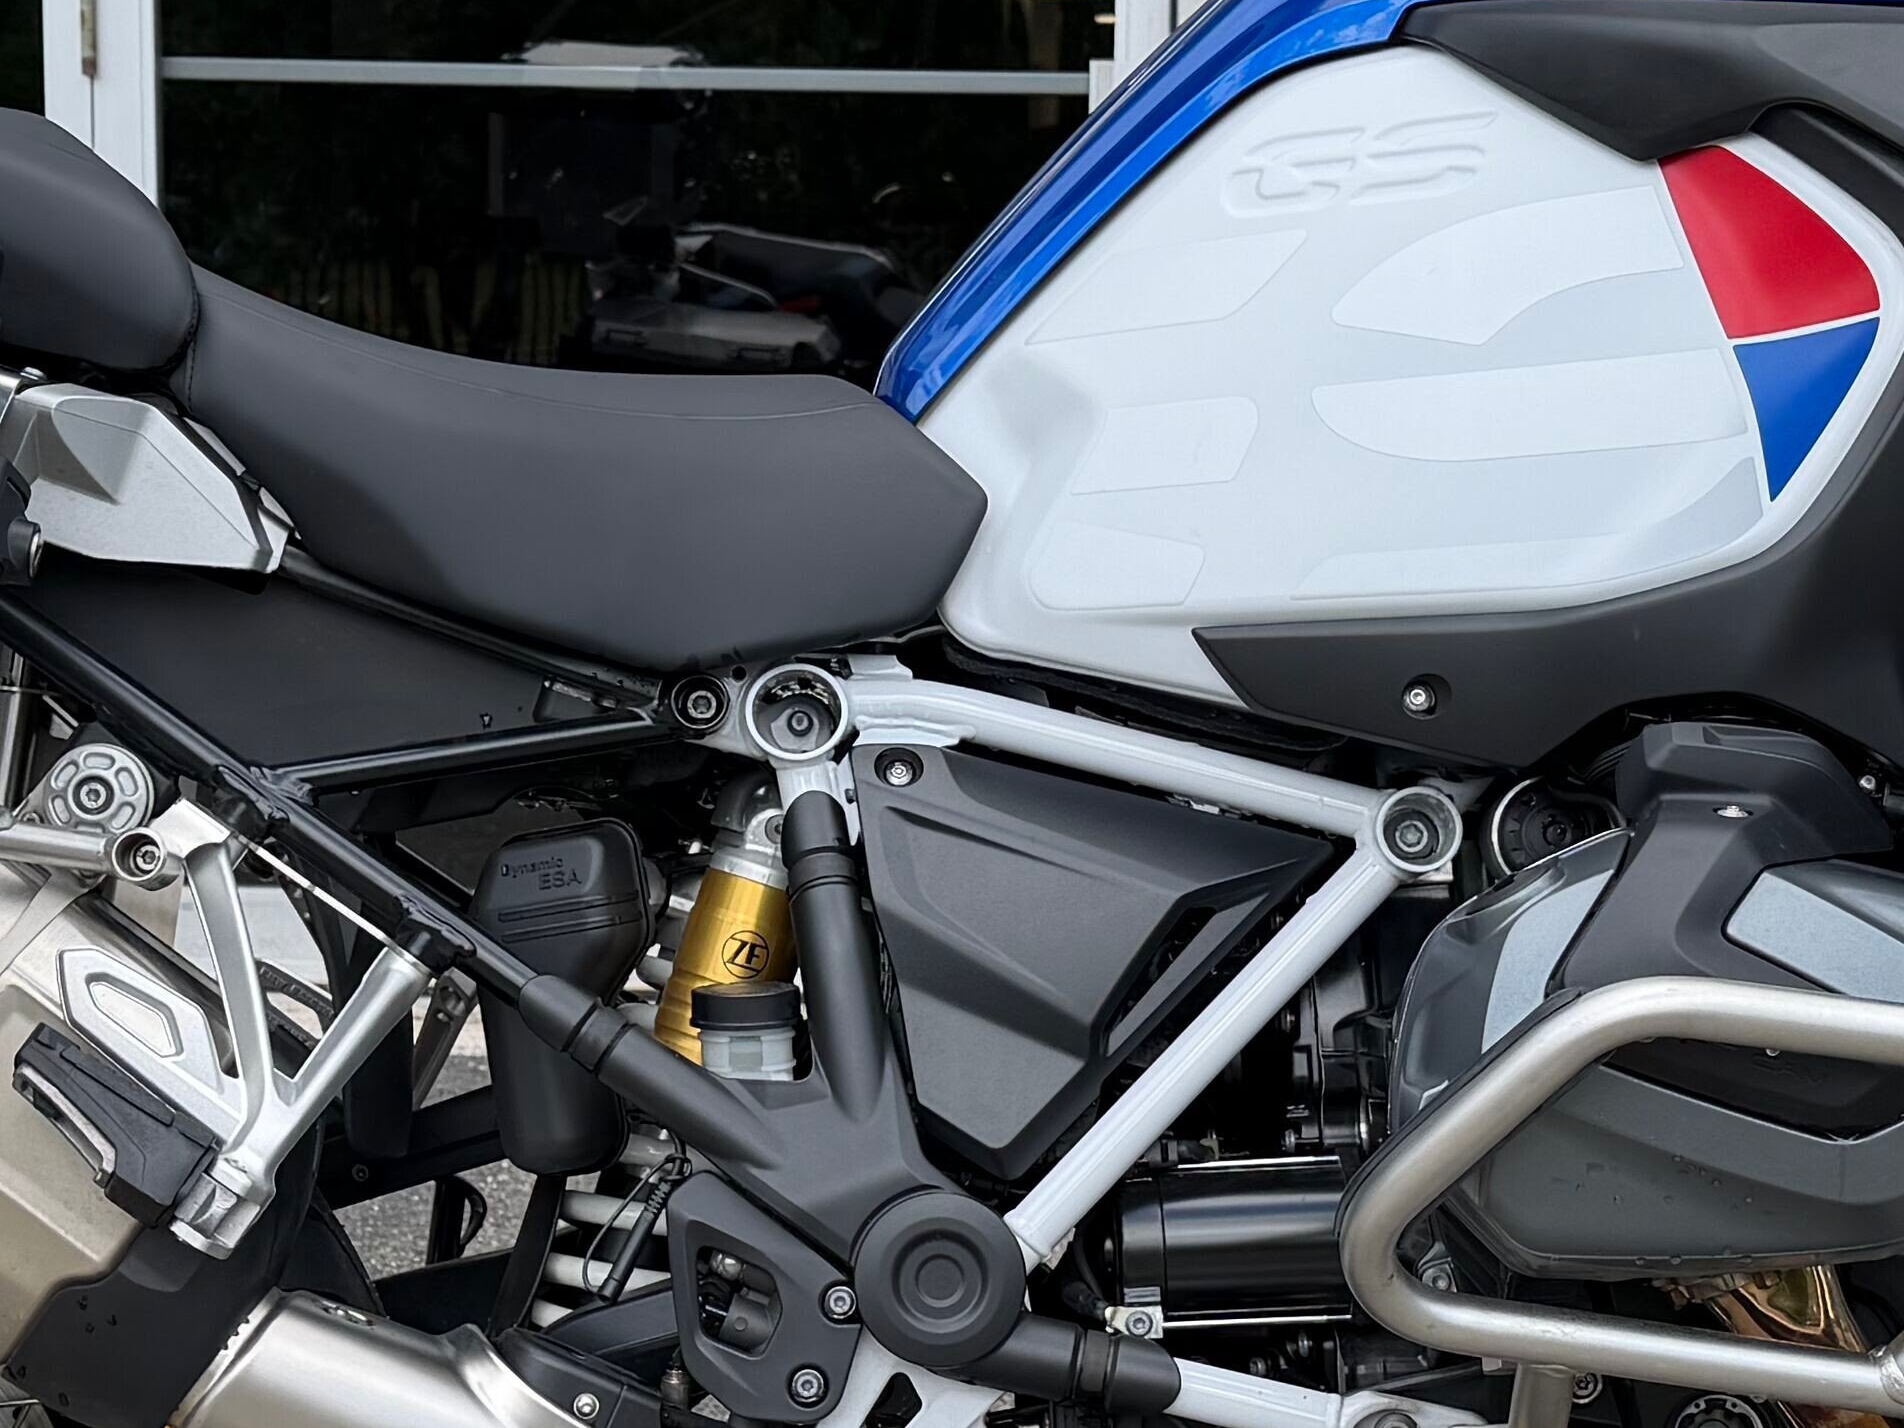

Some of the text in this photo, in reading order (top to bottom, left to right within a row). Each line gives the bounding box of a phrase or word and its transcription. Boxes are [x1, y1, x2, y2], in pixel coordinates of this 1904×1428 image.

[1221, 110, 1497, 218] GS
[500, 856, 563, 877] Dynamic
[538, 869, 583, 891] ESA
[725, 935, 768, 973] ZF
